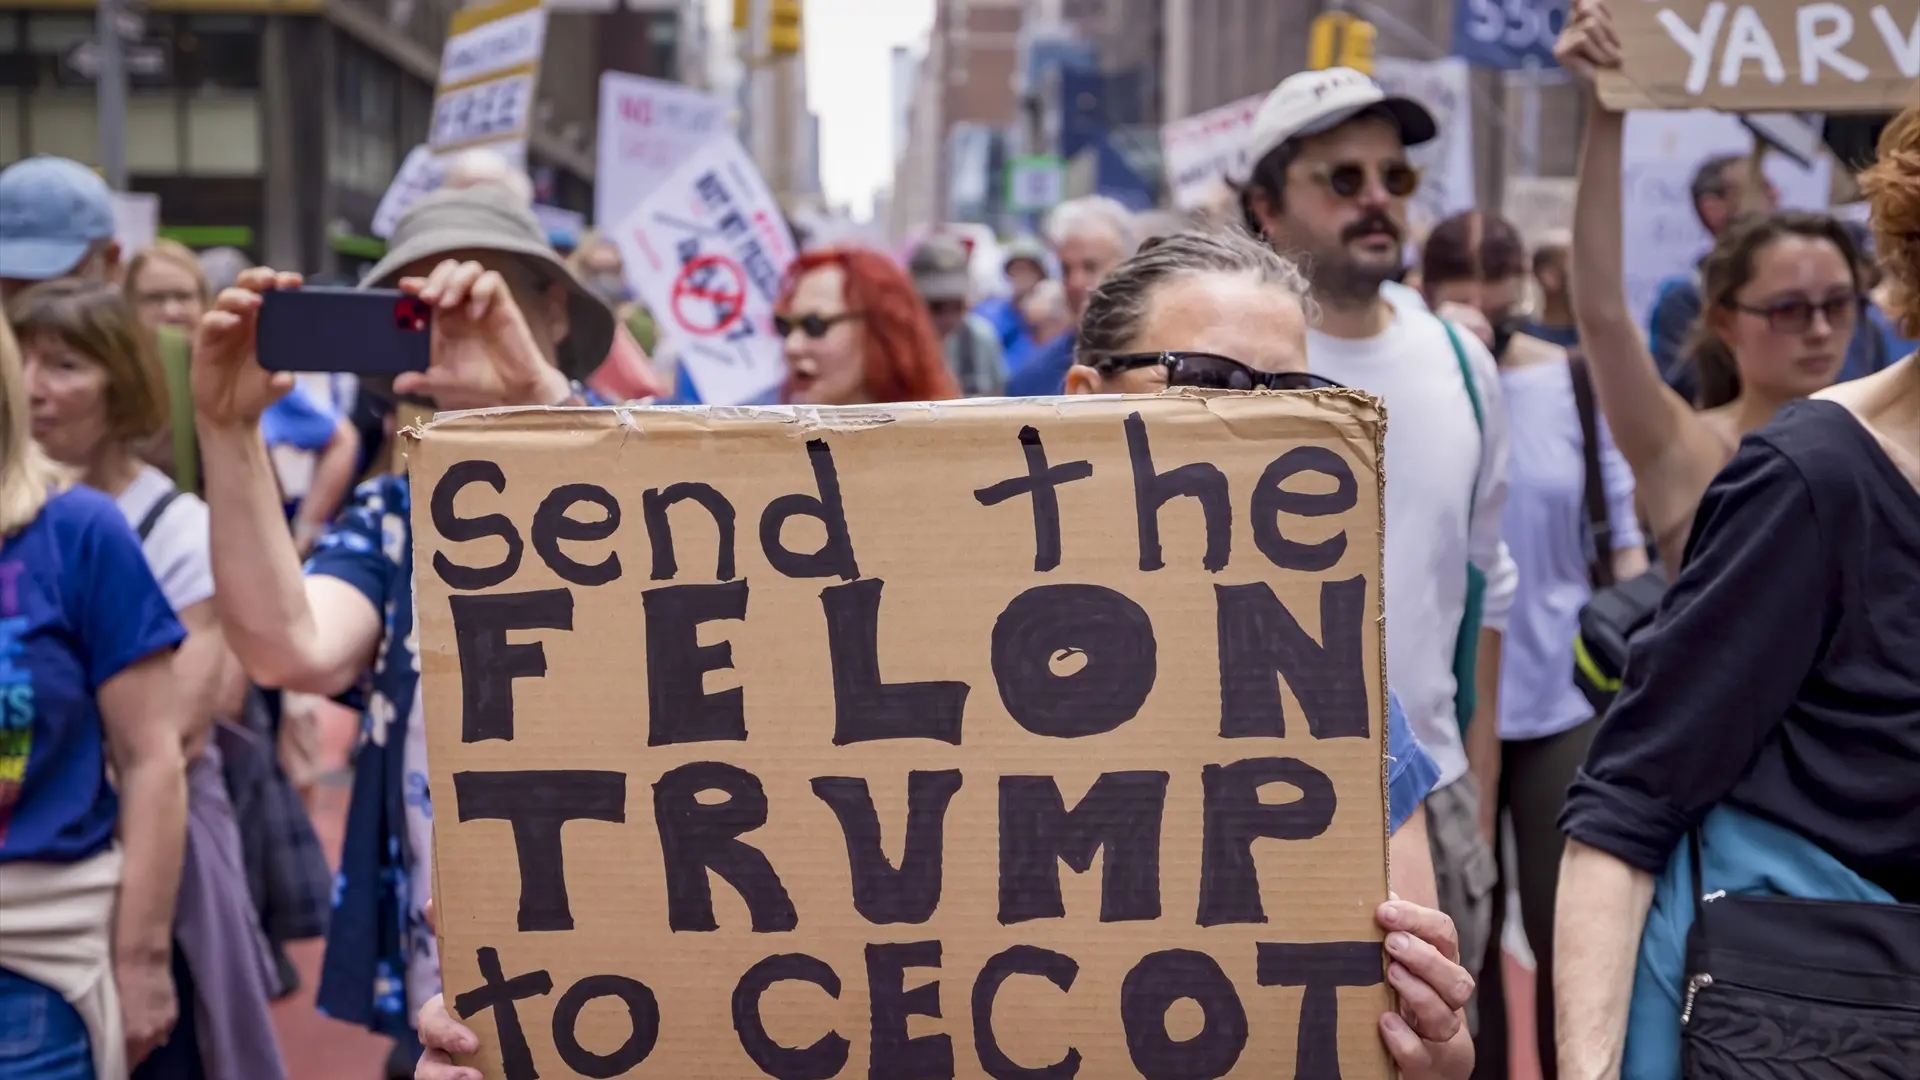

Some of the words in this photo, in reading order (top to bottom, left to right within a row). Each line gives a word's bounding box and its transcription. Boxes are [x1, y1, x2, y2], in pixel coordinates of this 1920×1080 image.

[431, 438, 860, 590] Send
[974, 411, 1358, 573] the
[448, 574, 1370, 746] FELON
[453, 757, 1337, 933] TRUMP
[454, 947, 660, 1080] to
[732, 940, 1384, 1080] CECOT
